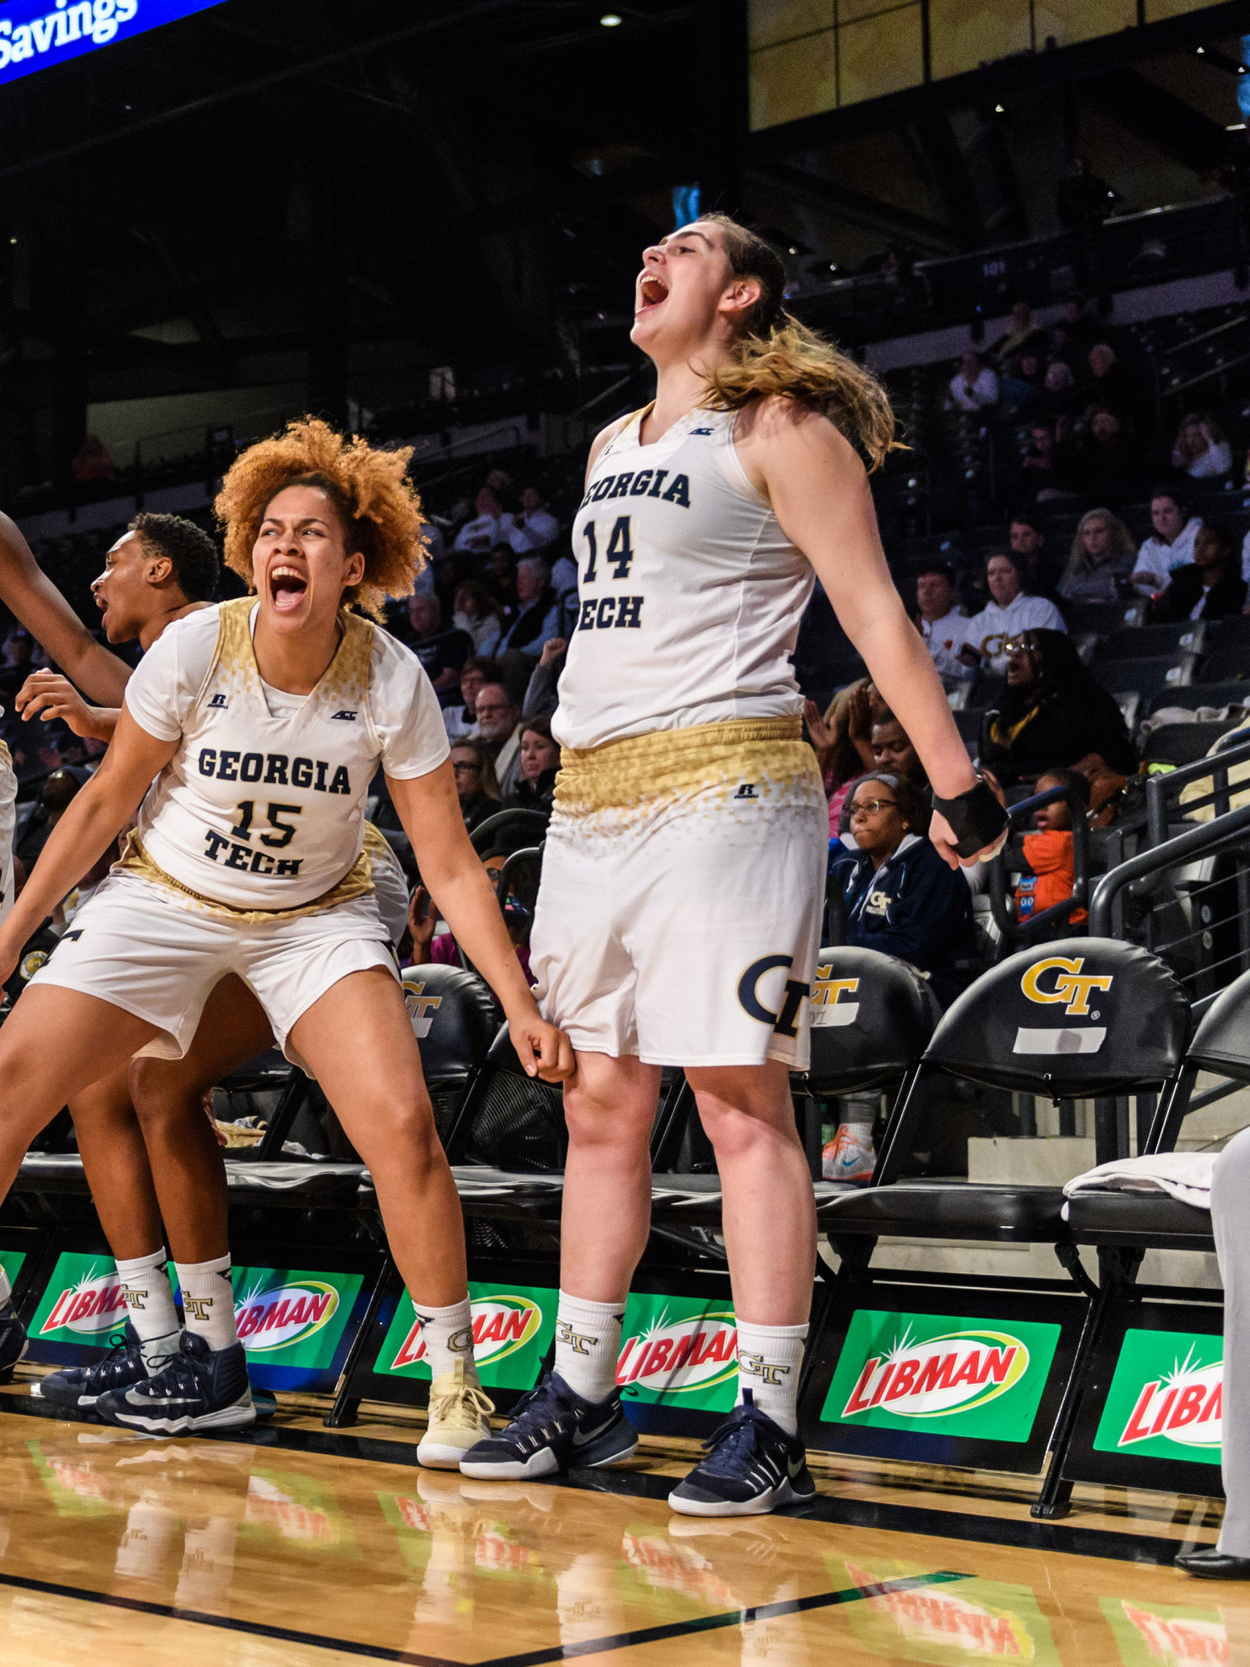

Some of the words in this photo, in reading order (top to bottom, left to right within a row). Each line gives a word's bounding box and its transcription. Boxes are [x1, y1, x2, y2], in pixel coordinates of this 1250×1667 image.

[578, 469, 692, 511] EORGIA
[582, 514, 635, 585] 14
[577, 596, 645, 632] ECH
[330, 710, 359, 721] ACC
[198, 748, 352, 796] GEORGIA
[229, 799, 305, 849] 15
[204, 829, 305, 877] TECH
[1021, 956, 1114, 1016] GT
[40, 1284, 128, 1334] LIBMA
[738, 1349, 790, 1386] GT
[841, 1345, 1020, 1418] LIBMAN
